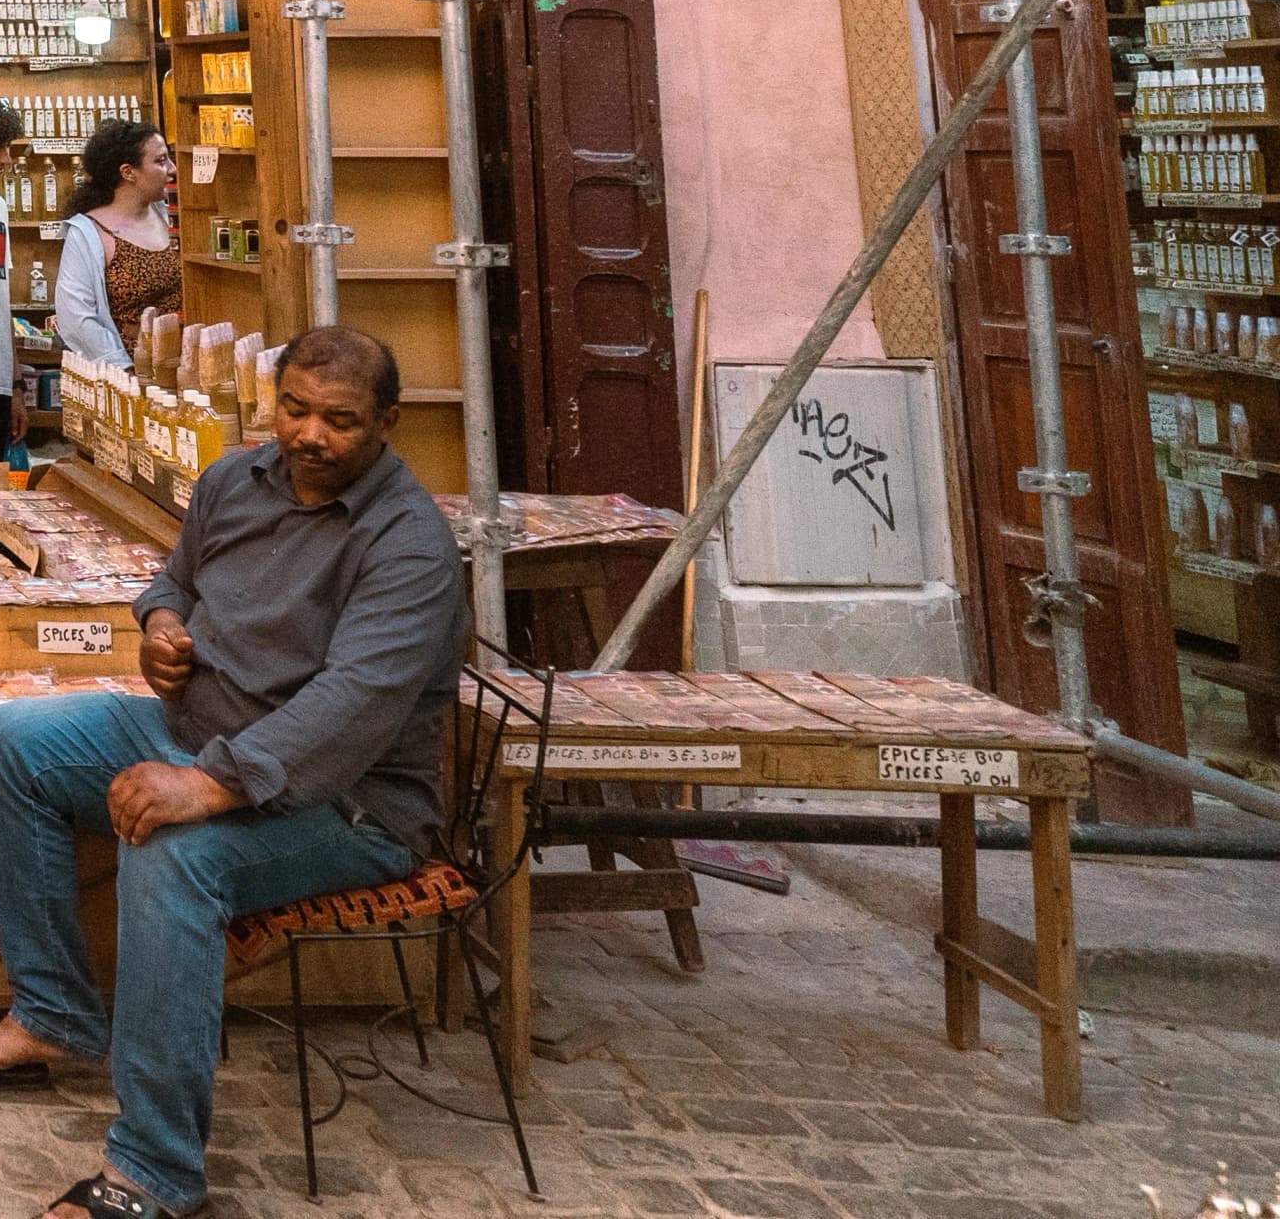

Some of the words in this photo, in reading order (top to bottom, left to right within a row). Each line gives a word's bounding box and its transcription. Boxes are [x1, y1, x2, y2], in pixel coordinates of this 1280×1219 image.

[42, 627, 85, 642] SPICES
[90, 624, 109, 636] BIO
[974, 751, 1003, 766] BIO
[880, 764, 943, 780] SPICES
[960, 769, 981, 786] 30
[990, 775, 1012, 787] DH
